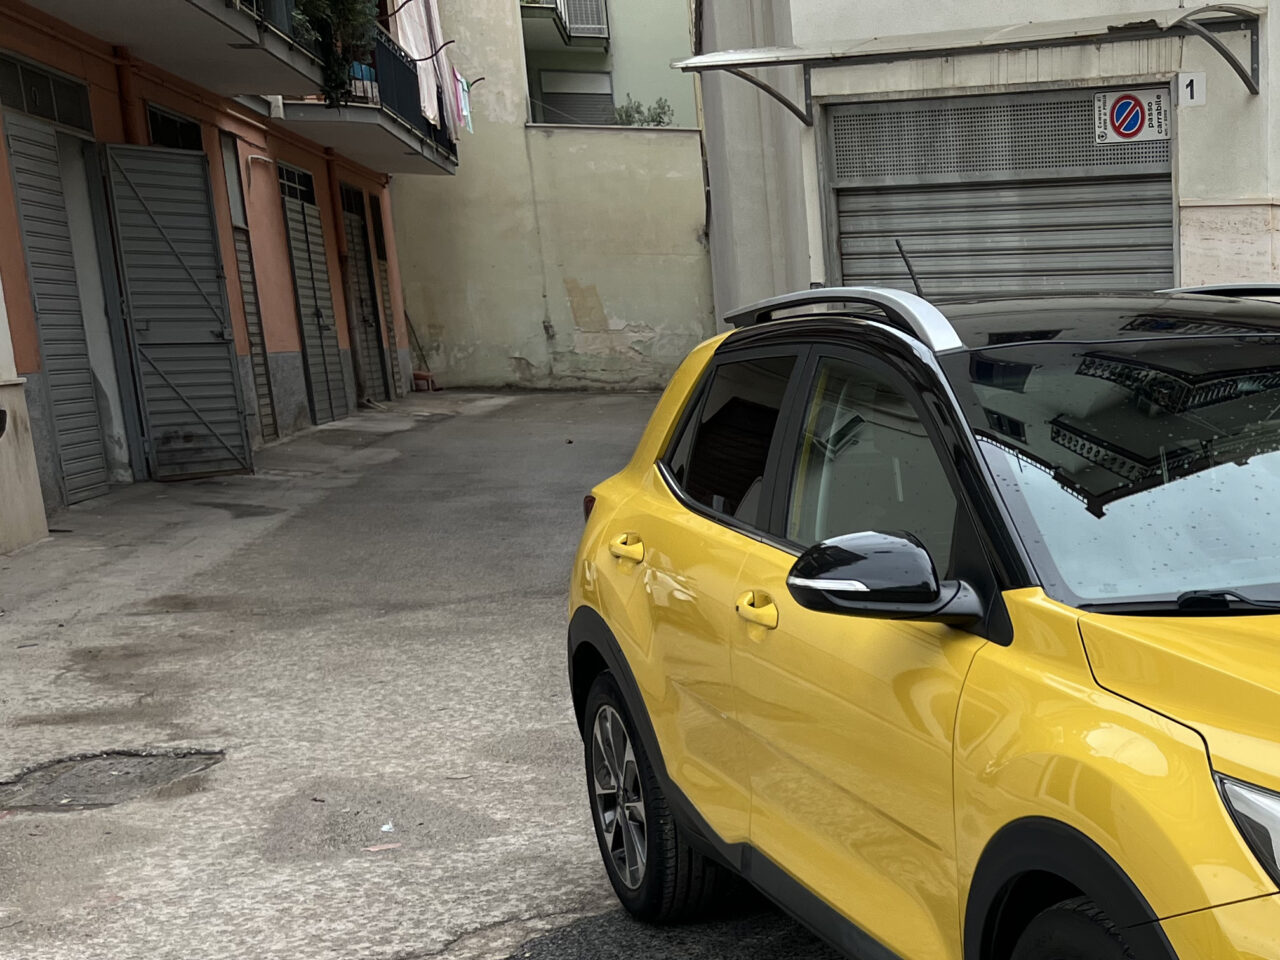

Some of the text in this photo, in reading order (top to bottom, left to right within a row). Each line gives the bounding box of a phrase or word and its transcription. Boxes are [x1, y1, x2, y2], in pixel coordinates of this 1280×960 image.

[1185, 78, 1195, 100] 1
[1147, 101, 1155, 129] passo
[1155, 94, 1163, 135] carrabile
